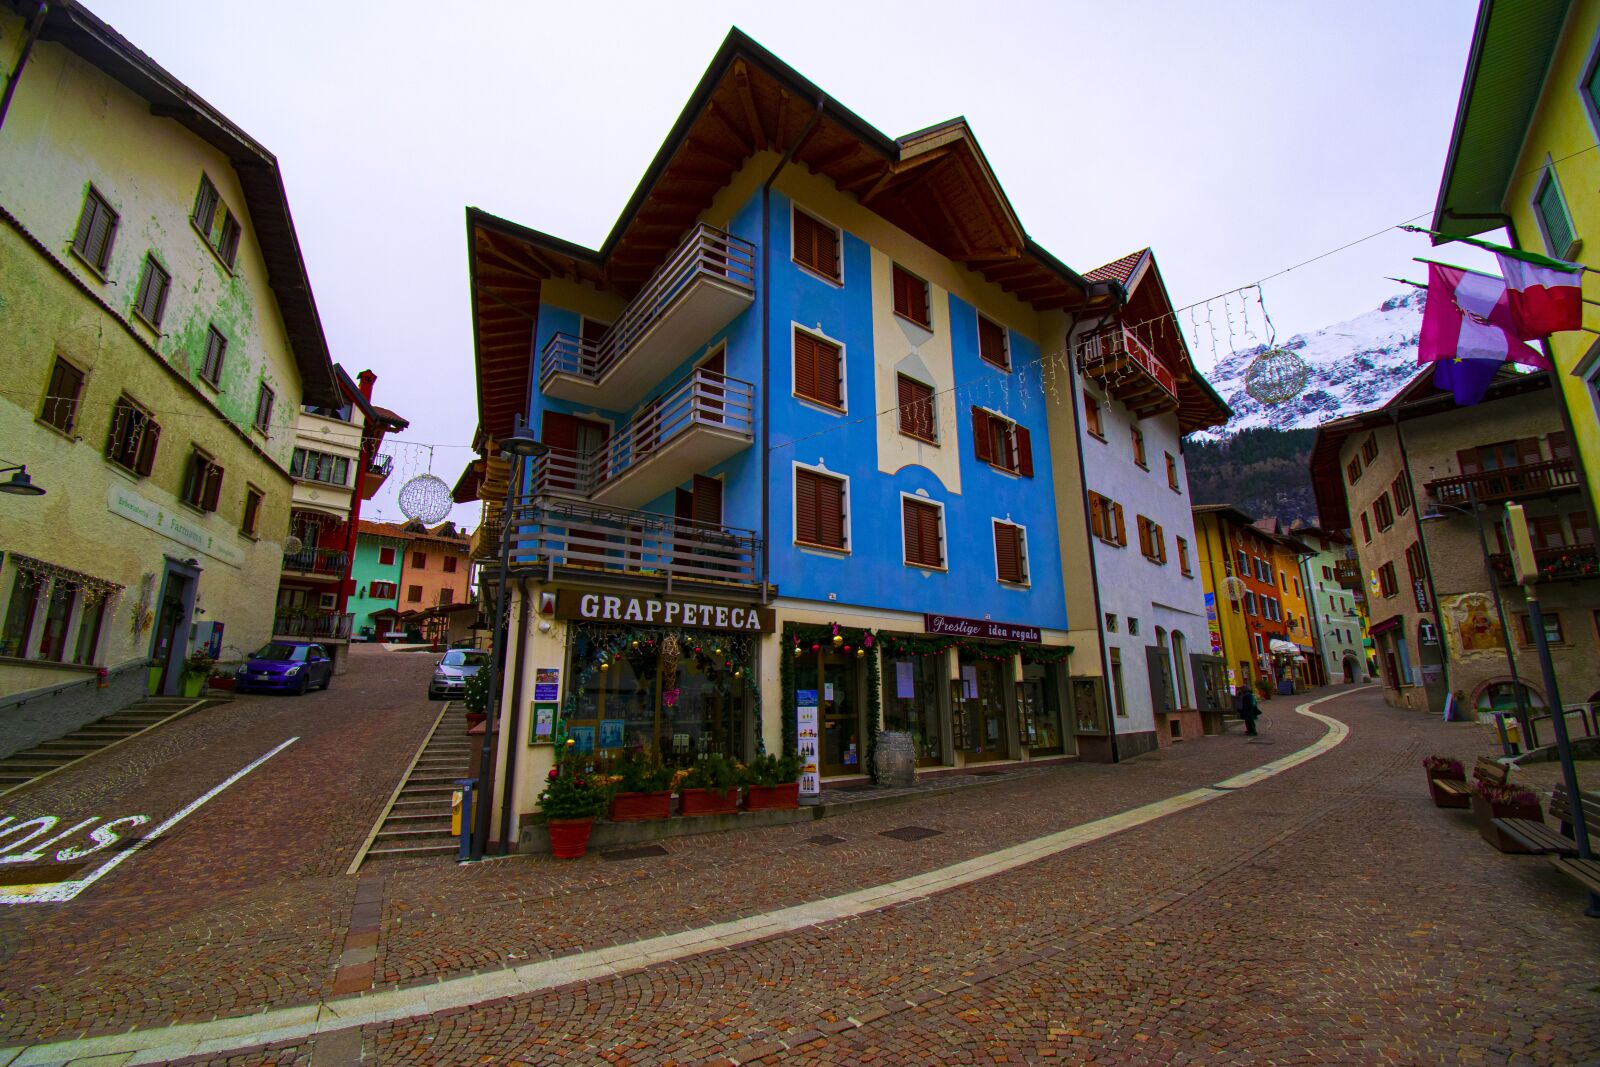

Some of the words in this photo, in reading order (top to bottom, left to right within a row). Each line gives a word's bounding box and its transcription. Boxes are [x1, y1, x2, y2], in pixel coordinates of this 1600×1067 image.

[580, 593, 761, 630] GRAPPETECA
[932, 616, 981, 635] Prestige
[988, 624, 1007, 637] idea
[1011, 629, 1038, 641] regalo
